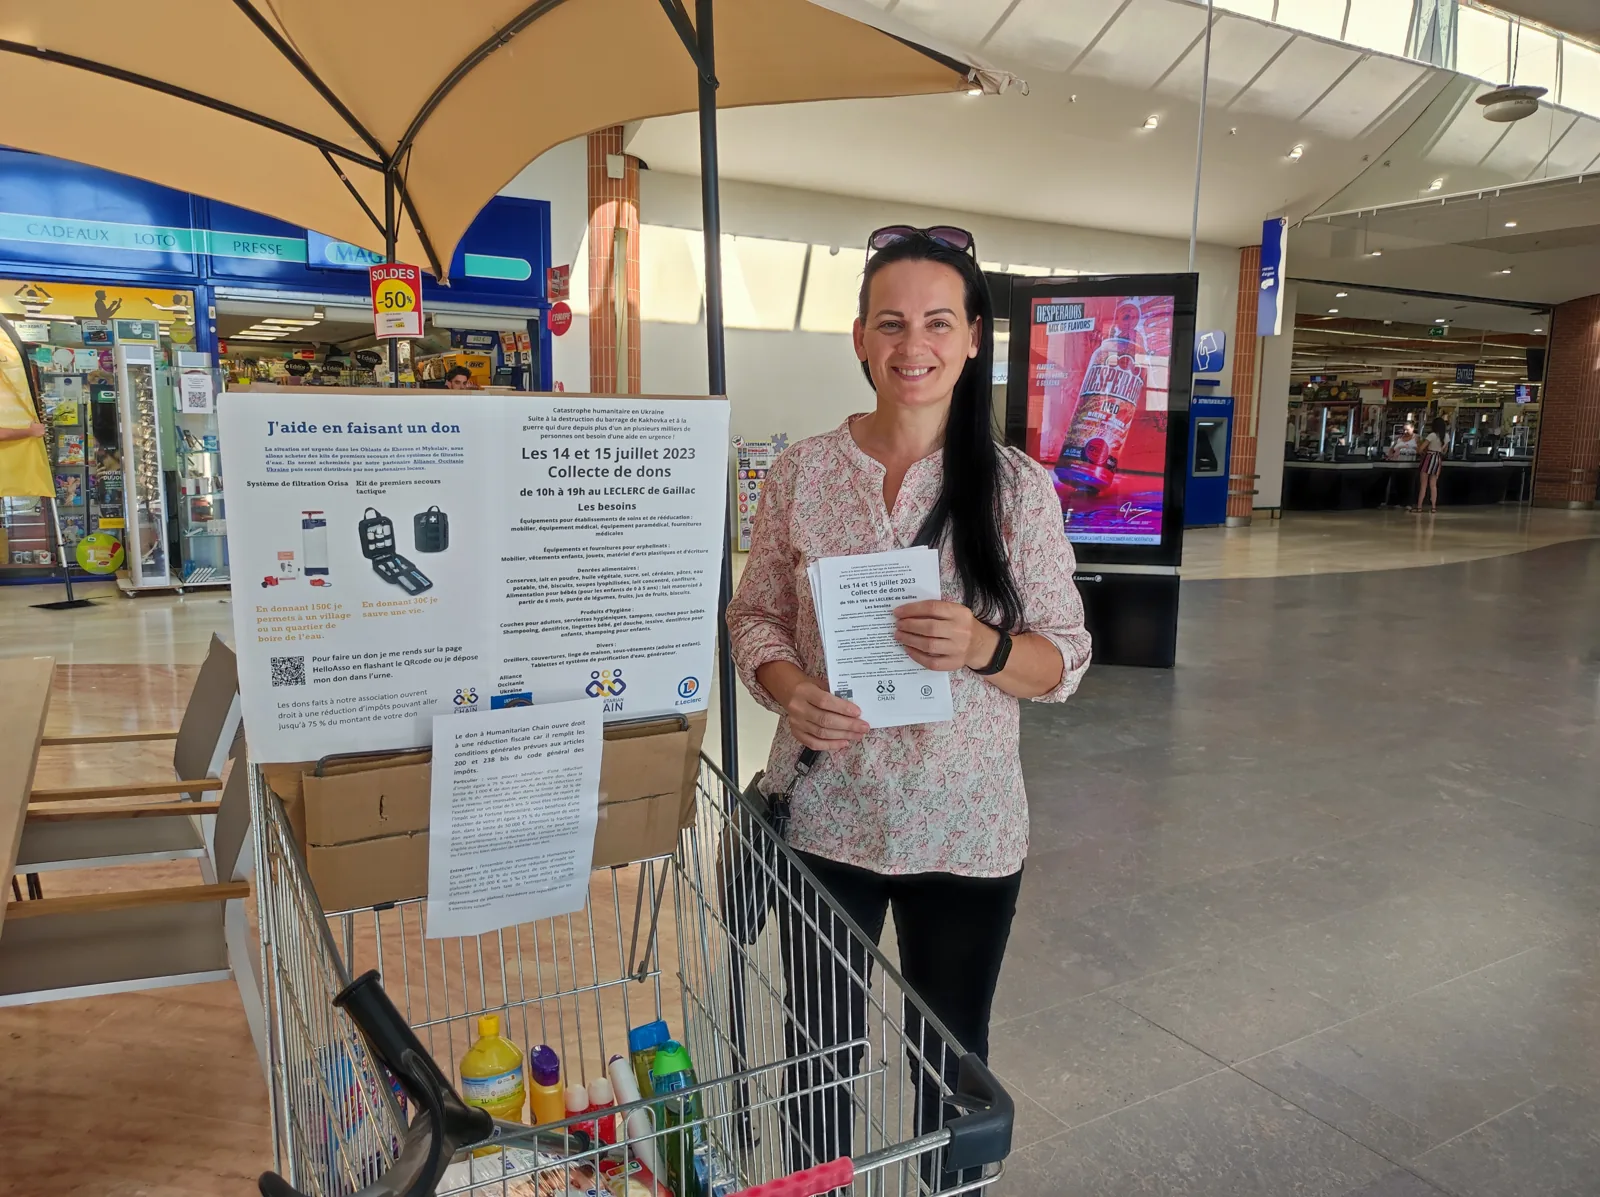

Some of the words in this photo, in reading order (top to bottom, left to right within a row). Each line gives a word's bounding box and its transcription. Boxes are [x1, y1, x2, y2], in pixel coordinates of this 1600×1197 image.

[26, 222, 110, 242] CADEAUX
[134, 233, 176, 247] LOTO
[233, 240, 283, 256] PRESSE
[372, 268, 415, 281] SOLDES
[1036, 304, 1082, 323] DESPERADOS
[1067, 321, 1091, 331] FLAVORS
[267, 421, 317, 436] J'aide
[322, 425, 343, 433] en
[347, 422, 403, 434] faisant
[407, 425, 427, 433] un
[431, 422, 460, 433] don
[522, 447, 548, 460] Les
[553, 447, 570, 460] 14
[574, 448, 590, 460] et
[595, 447, 611, 460] 15
[614, 447, 658, 463] juillet
[663, 447, 695, 459] 2023
[548, 465, 610, 478] Collecte
[614, 465, 632, 477] de
[636, 466, 671, 477] dons
[520, 488, 533, 497] de
[536, 488, 555, 496] 10h
[557, 487, 564, 496] à
[567, 487, 585, 496] 19h
[604, 487, 645, 495] LECLERC
[648, 486, 660, 495] de
[662, 486, 695, 494] Gaillac
[578, 503, 595, 511] Les
[598, 502, 636, 511] besoins
[878, 579, 898, 588] juillet
[430, 596, 438, 604] je
[256, 605, 268, 613] En
[334, 603, 342, 611] je
[256, 616, 296, 624] permets
[319, 612, 352, 620] village
[285, 624, 323, 633] quartier
[312, 665, 350, 673] HelloAsso
[404, 658, 432, 666] QRcode
[498, 680, 524, 688] Occitanie
[603, 702, 623, 713] AIN
[675, 698, 702, 706] E.Leclerc
[486, 727, 530, 735] Humanitarian
[476, 738, 508, 746] réduction
[490, 746, 521, 754] générales
[523, 743, 548, 751] prévues
[546, 748, 569, 757] général
